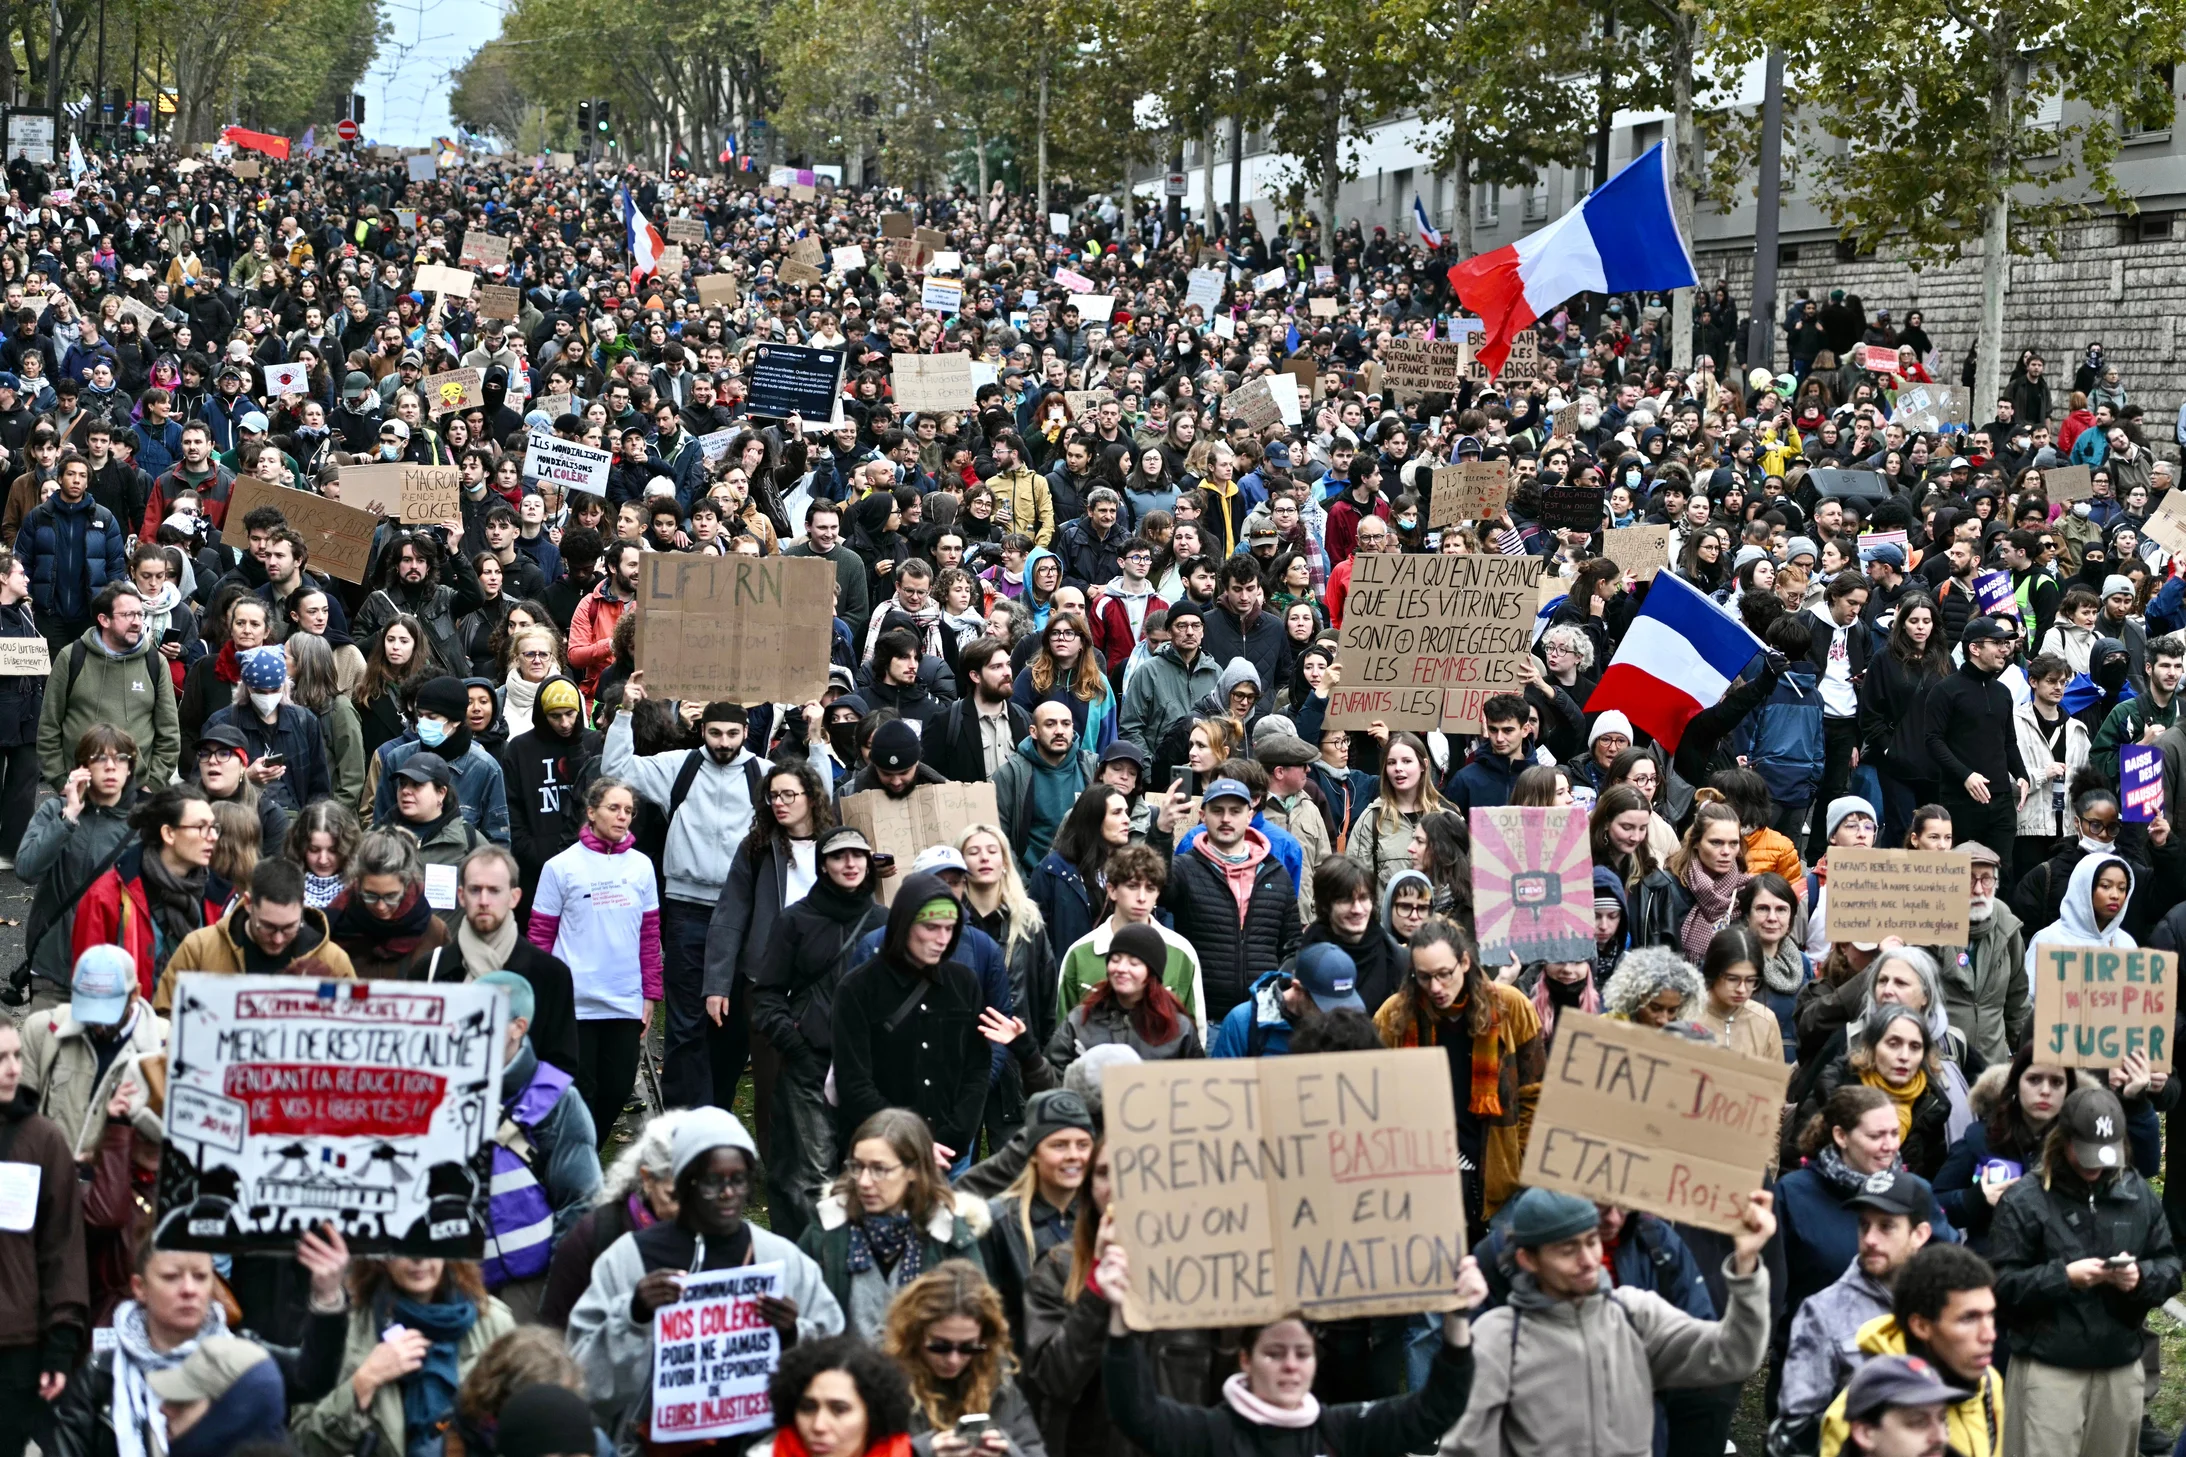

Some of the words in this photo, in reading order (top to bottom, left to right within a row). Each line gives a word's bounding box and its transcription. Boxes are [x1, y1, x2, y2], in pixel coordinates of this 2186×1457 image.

[1390, 338, 1412, 352] LBD,
[1511, 348, 1532, 359] LES
[936, 358, 964, 368] VAUT
[1398, 364, 1429, 375] FRANCE
[899, 388, 917, 398] QUE
[938, 388, 972, 398] PORTER
[1402, 377, 1414, 386] UN
[1414, 378, 1429, 388] JEU
[530, 434, 549, 450] ILS
[552, 444, 608, 463] MONDIALISENT
[537, 454, 593, 473] MONDIALISONS
[538, 464, 552, 478] LA
[553, 468, 589, 484] COLÈRE
[405, 470, 460, 492] MACRON,
[1436, 472, 1462, 490] C'EST
[402, 492, 435, 501] RENDS
[438, 492, 452, 501] LA
[406, 502, 458, 520] COKE!
[1544, 513, 1561, 521] PAS
[1353, 556, 1384, 583] IL
[1423, 556, 1483, 588] QU'EN
[1484, 558, 1543, 589] FRANCE
[1978, 574, 2006, 598] BAISSE
[1992, 584, 2008, 600] DES
[1350, 590, 1390, 617] QUE
[1396, 589, 1430, 619] LES
[1440, 590, 1524, 620] VITRINES
[1344, 624, 1399, 650] SONT
[1418, 622, 1506, 654] PROTÉGÉES
[1508, 628, 1532, 654] QUE
[1363, 656, 1398, 682] LES
[1412, 656, 1482, 684] FEMMES,
[1484, 659, 1514, 682] LES
[1330, 690, 1398, 715] ENFANTS,
[1400, 690, 1436, 716] LES
[542, 758, 556, 784] I
[2124, 750, 2152, 773] BAISSE
[2139, 766, 2153, 782] DES
[1834, 862, 1868, 872] ENFANTS
[1914, 864, 1932, 874] VOUS
[1881, 900, 1897, 909] AVEC
[1935, 900, 1945, 910] ils
[2050, 951, 2166, 984] TIRER
[2066, 989, 2118, 1009] N'EST
[2122, 986, 2164, 1014] PAS
[216, 1028, 286, 1062] MERCI
[296, 1030, 325, 1062] DE
[326, 1030, 402, 1066] RESTER
[406, 1030, 474, 1068] CALME
[2049, 1024, 2165, 1061] JUGER
[226, 1065, 310, 1094] PENDANT
[312, 1070, 333, 1091] LA
[1560, 1032, 1671, 1102] ETAT
[252, 1098, 272, 1120] DE
[280, 1098, 312, 1119] VOS
[314, 1098, 409, 1122] LIBERTÉS
[1118, 1078, 1260, 1134] C'EST
[1296, 1068, 1380, 1128] EN
[2095, 1116, 2114, 1138] NY
[1114, 1134, 1316, 1199] PRENANT
[1328, 1127, 1456, 1178] BASTILLE
[1539, 1126, 1651, 1195] ETAT
[1666, 1163, 1746, 1222] Rois
[1135, 1202, 1248, 1246] QU'ON
[1292, 1198, 1318, 1230] A
[1352, 1189, 1412, 1224] EU
[1148, 1248, 1275, 1306] NOTRE
[1296, 1232, 1462, 1298] NATION
[683, 1276, 776, 1303] CRIMINALISENT
[660, 1308, 694, 1344] NOS
[660, 1343, 695, 1367] POUR
[700, 1340, 716, 1361] NE
[722, 1332, 771, 1358] JAMAIS
[659, 1368, 695, 1389] AVOIR
[712, 1356, 770, 1381] RÉPONDRE
[708, 1385, 720, 1397] DE
[657, 1403, 696, 1428] LEURS
[701, 1391, 770, 1424] INJUSTICES
